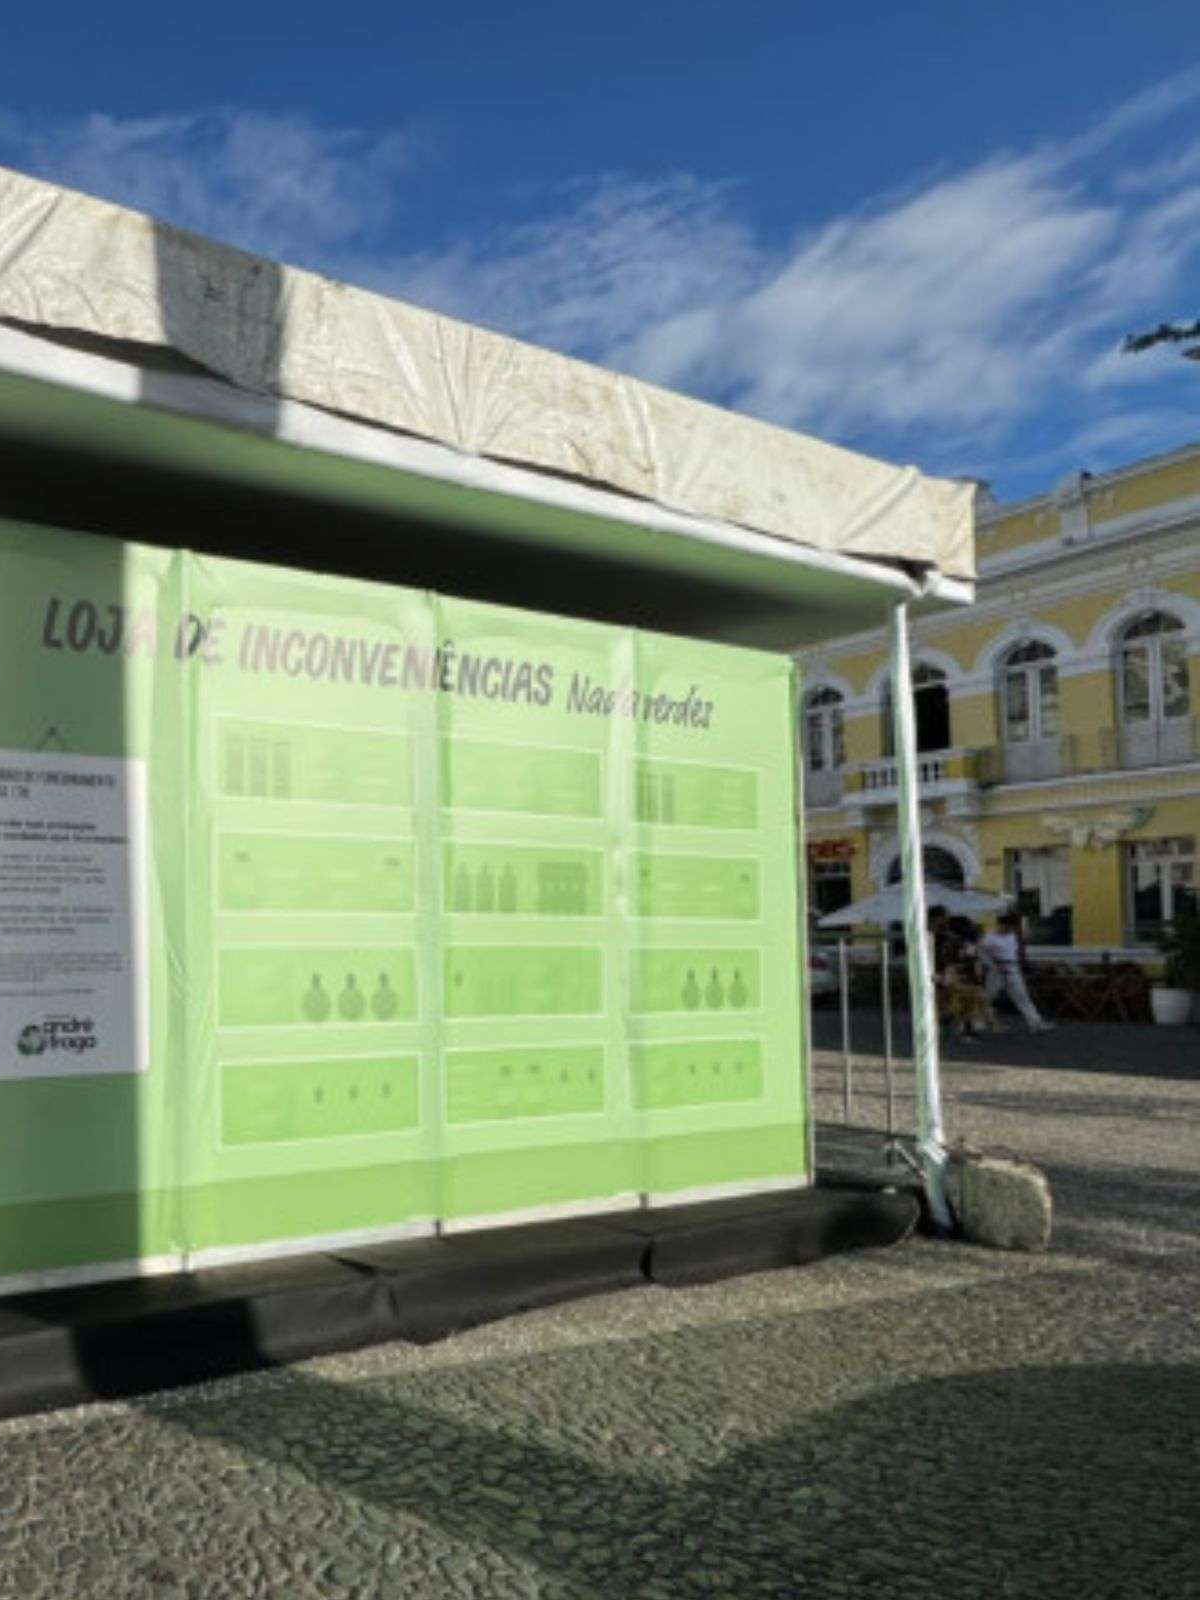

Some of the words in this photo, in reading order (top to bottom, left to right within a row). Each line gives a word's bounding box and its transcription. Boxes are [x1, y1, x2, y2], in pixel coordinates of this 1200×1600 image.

[41, 597, 157, 657] LOJA
[174, 612, 227, 664] DE
[237, 624, 554, 706] INCONVENIÊNCIAS
